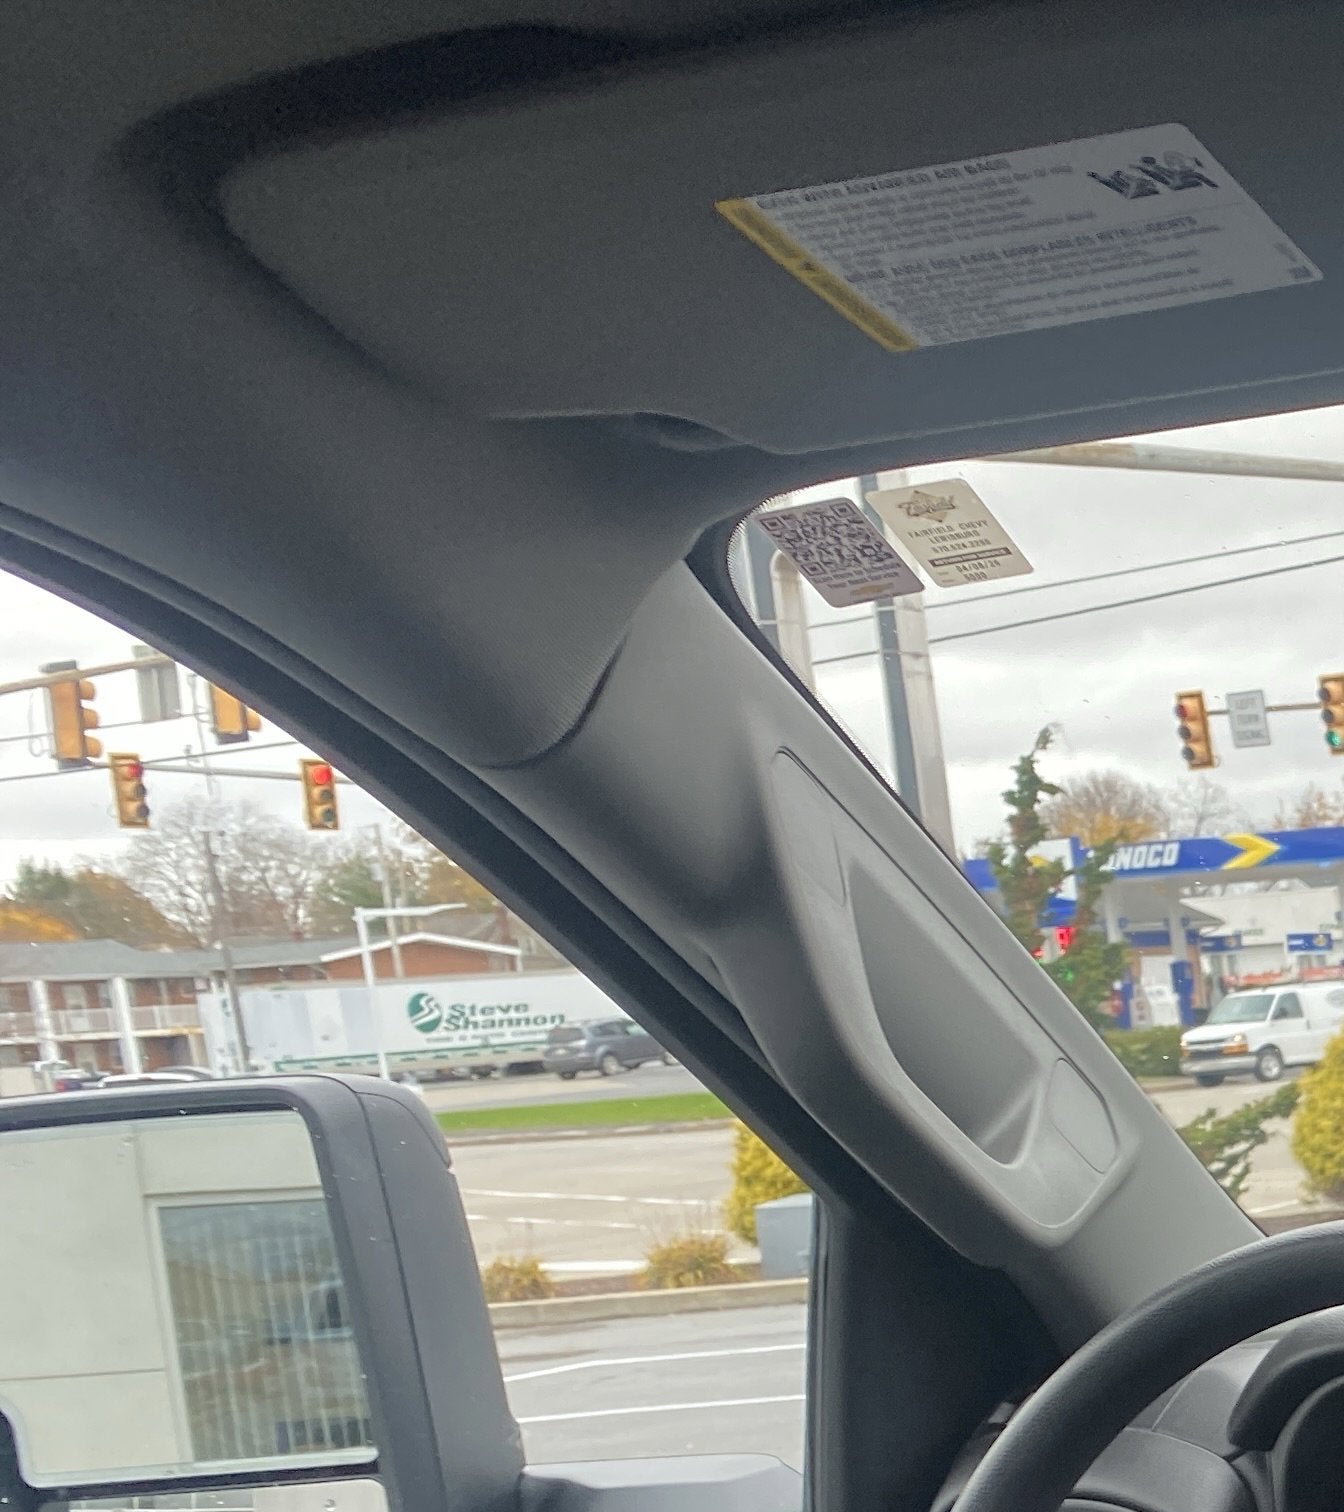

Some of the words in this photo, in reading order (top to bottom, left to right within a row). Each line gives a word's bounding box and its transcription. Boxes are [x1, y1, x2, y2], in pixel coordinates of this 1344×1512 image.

[1099, 841, 1181, 871] NOCO
[449, 1002, 529, 1017] Steve
[442, 1013, 566, 1032] Shannon
